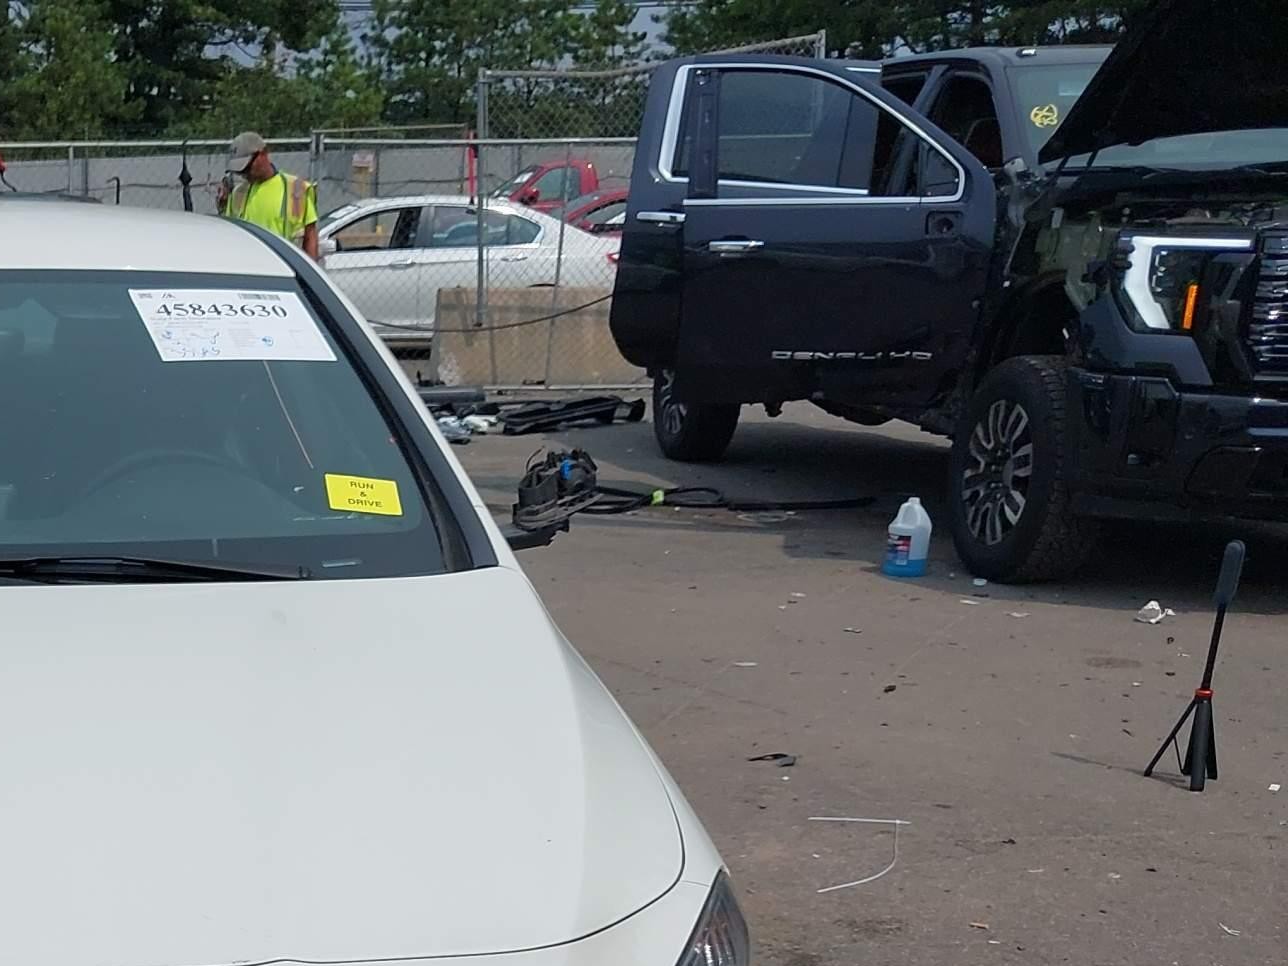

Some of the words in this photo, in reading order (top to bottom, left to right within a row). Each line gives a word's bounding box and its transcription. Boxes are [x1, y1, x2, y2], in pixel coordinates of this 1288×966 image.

[156, 302, 289, 318] 45843630
[349, 481, 374, 490] RUN
[347, 498, 383, 508] DRIVE
